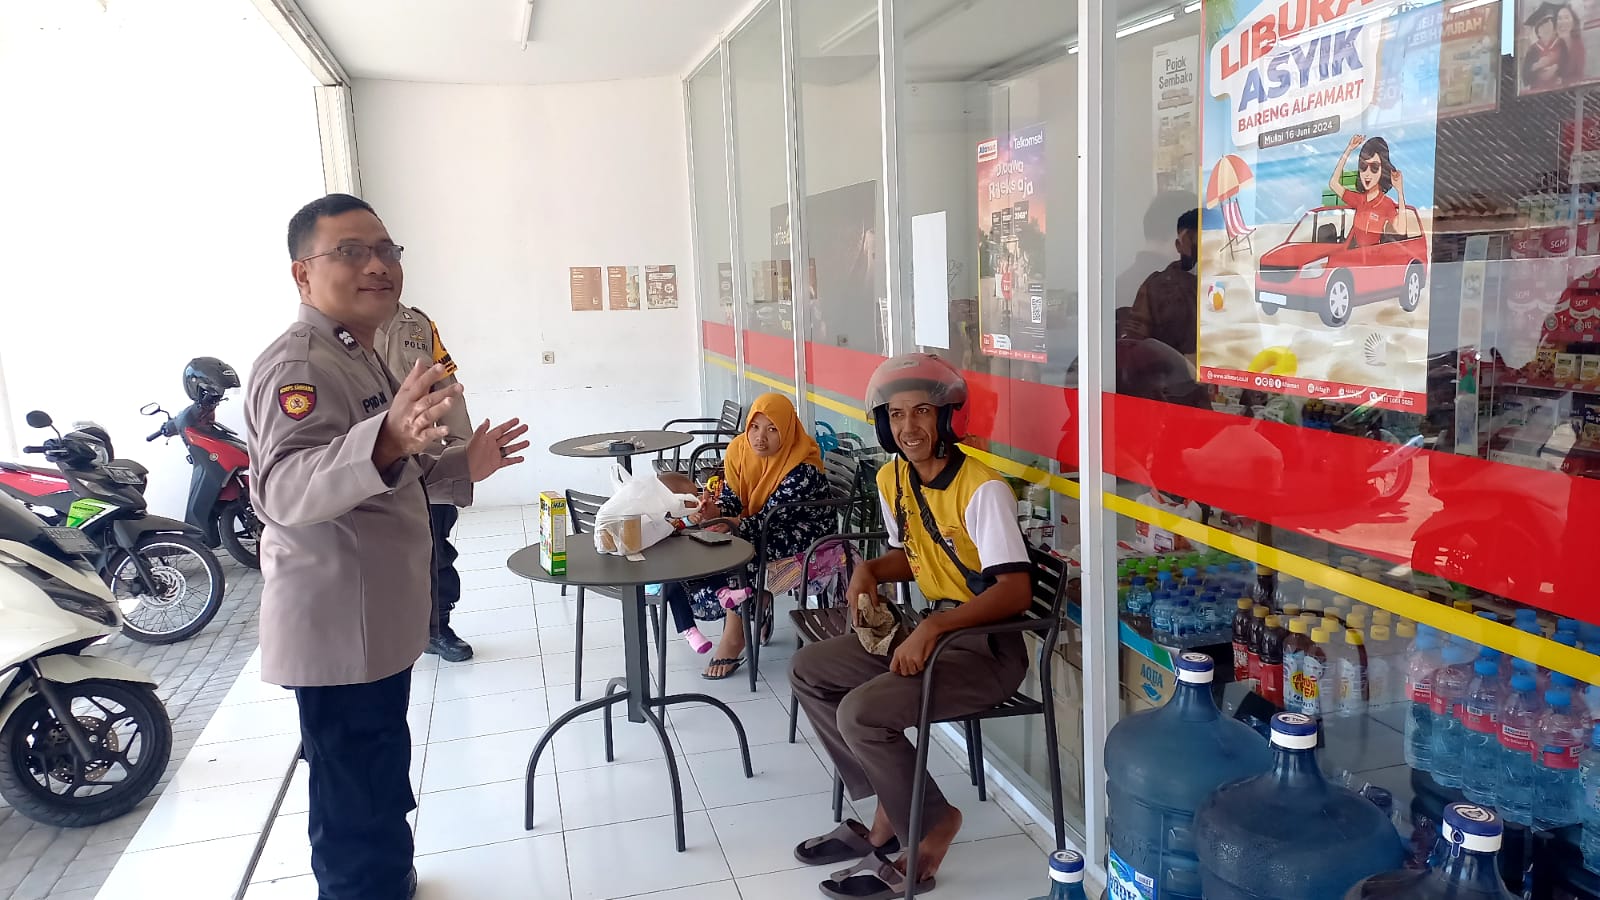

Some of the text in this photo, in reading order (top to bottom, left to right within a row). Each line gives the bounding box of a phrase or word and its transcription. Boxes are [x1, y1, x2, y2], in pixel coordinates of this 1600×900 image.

[1166, 56, 1186, 71] Pojok
[1238, 25, 1364, 112] ASYIK
[1159, 72, 1193, 89] Sembako
[1238, 104, 1289, 132] BARENG
[1292, 79, 1364, 115] ALFAMART
[1013, 130, 1043, 149] Telkomsel
[1264, 121, 1333, 145] Mulai 16 Juni 2024
[1551, 239, 1567, 248] SGM
[1141, 663, 1163, 688] AQUA
